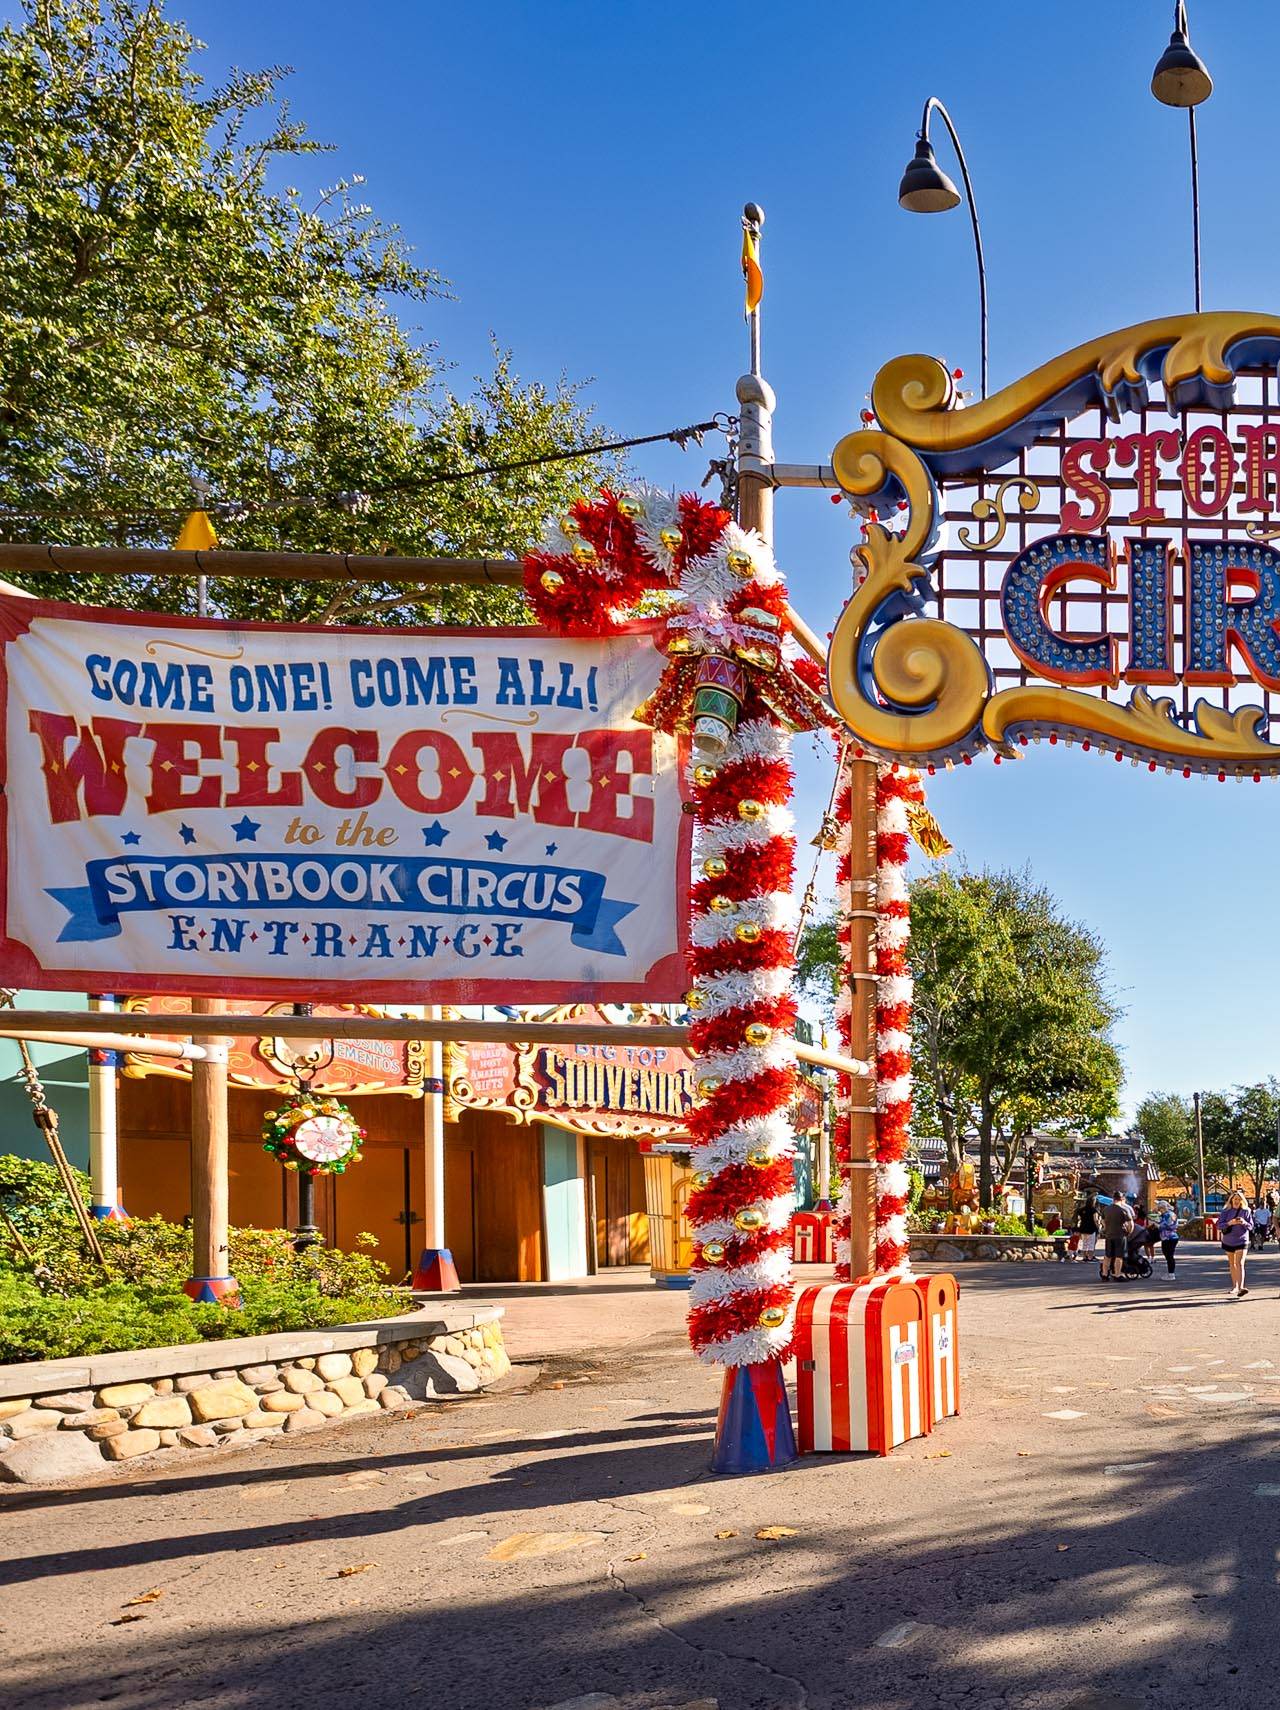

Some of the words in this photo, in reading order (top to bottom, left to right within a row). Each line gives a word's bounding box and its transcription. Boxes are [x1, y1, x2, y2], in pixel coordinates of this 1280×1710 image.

[85, 654, 215, 713] COME
[230, 661, 332, 713] ONE!
[350, 656, 478, 708] COME
[499, 657, 598, 713] ALL!
[28, 709, 656, 843] WELCOME
[283, 815, 326, 847] to
[335, 811, 399, 849] the
[104, 860, 405, 904] STORYBOOK
[416, 866, 584, 914] CIRCUS
[543, 1047, 697, 1118] SOUVENIRS
[624, 1046, 668, 1067] TOP
